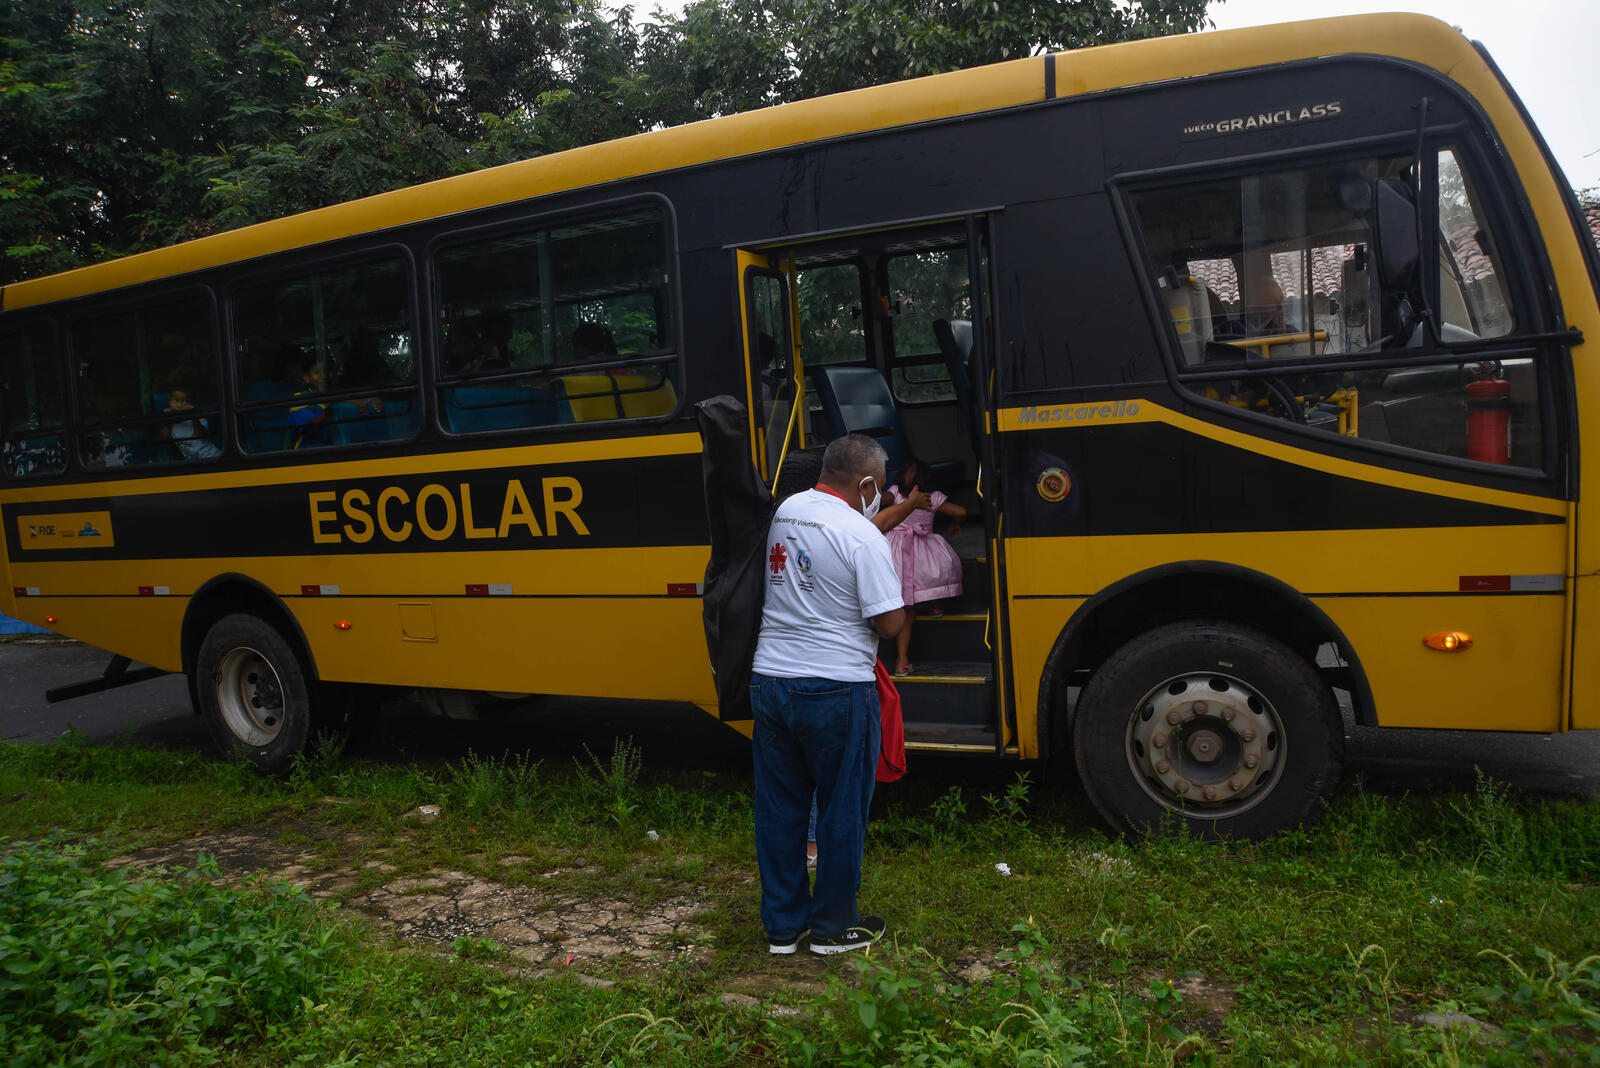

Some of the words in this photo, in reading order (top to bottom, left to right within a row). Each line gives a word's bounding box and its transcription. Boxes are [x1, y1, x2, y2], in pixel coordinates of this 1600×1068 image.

[1184, 123, 1214, 134] IVECO
[1216, 101, 1341, 133] GRANCLASS
[1018, 400, 1140, 424] Mascarello
[308, 476, 591, 544] ESCOLAR
